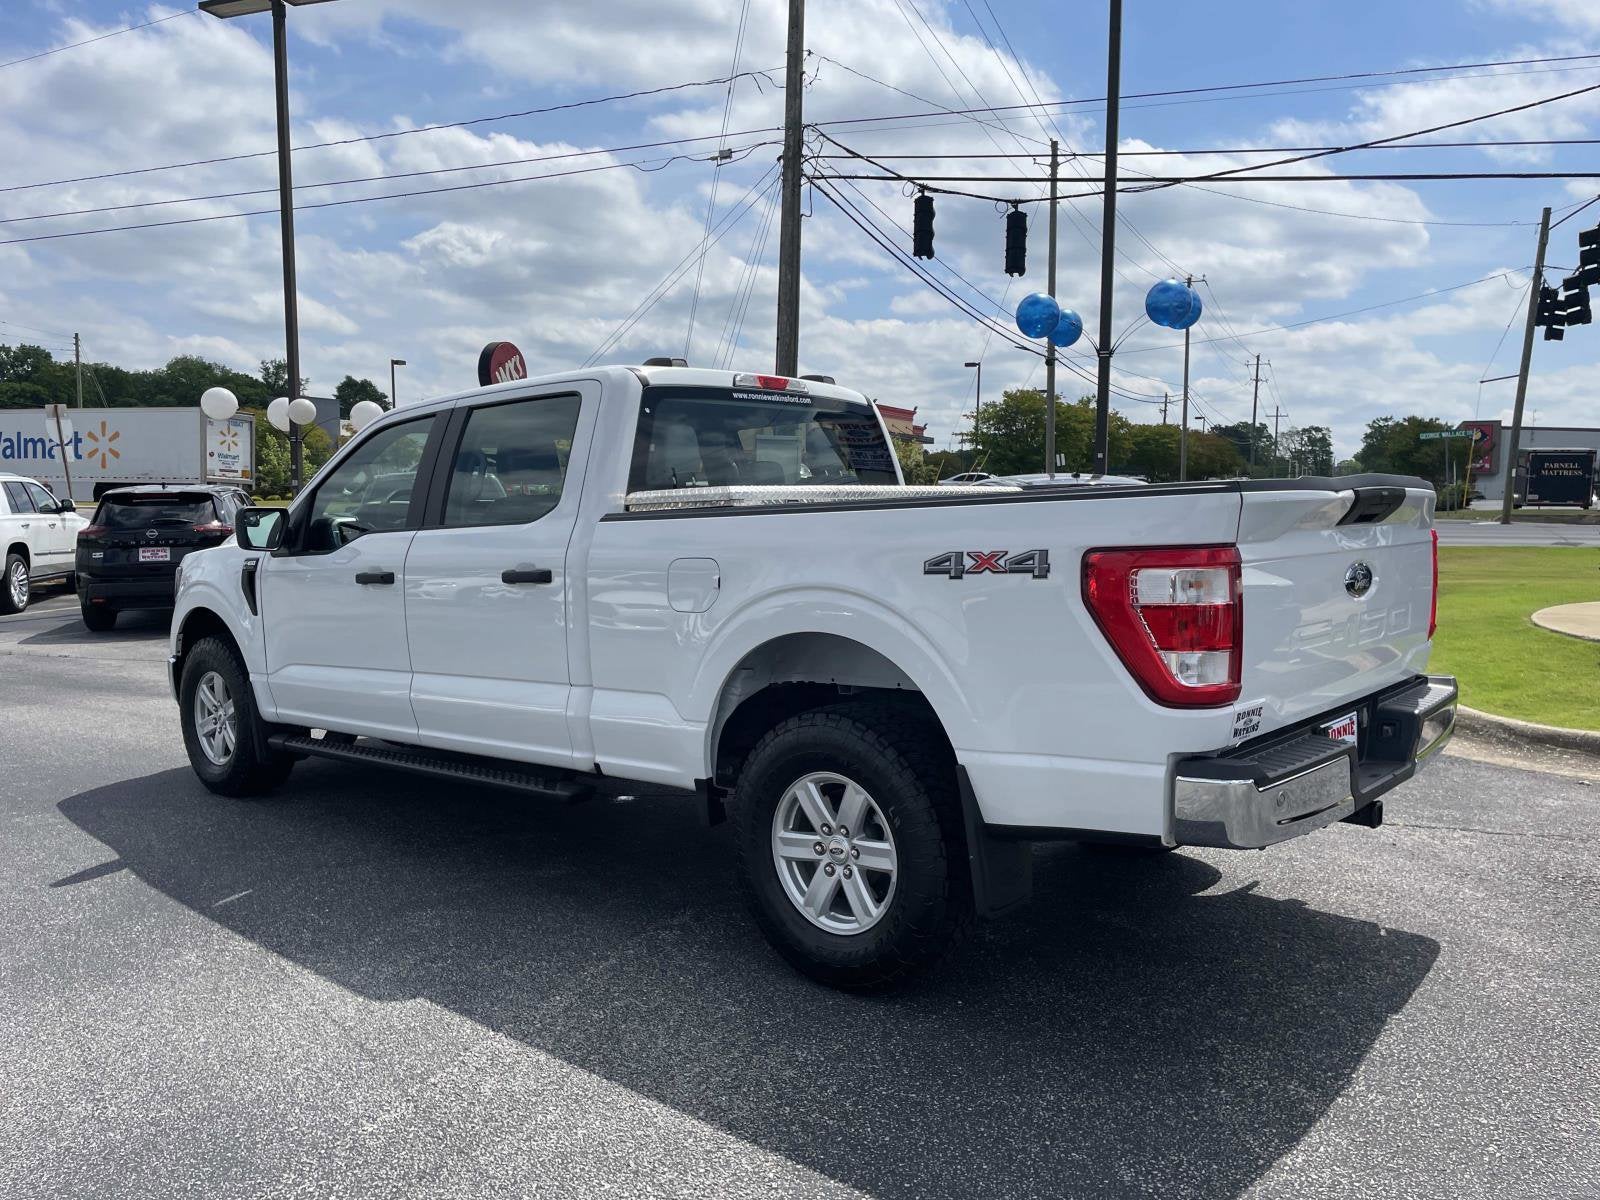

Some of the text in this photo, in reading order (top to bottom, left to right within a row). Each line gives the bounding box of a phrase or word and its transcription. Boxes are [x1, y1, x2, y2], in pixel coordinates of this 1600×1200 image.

[732, 392, 812, 404] www.ronniewatkinsford.com
[1419, 432, 1440, 440] GEORGE
[1441, 430, 1466, 439] WALLACE
[0, 431, 83, 460] almat
[217, 452, 240, 461] Walmart
[1235, 706, 1263, 725] RONNIE
[1232, 720, 1260, 739] WATKINS
